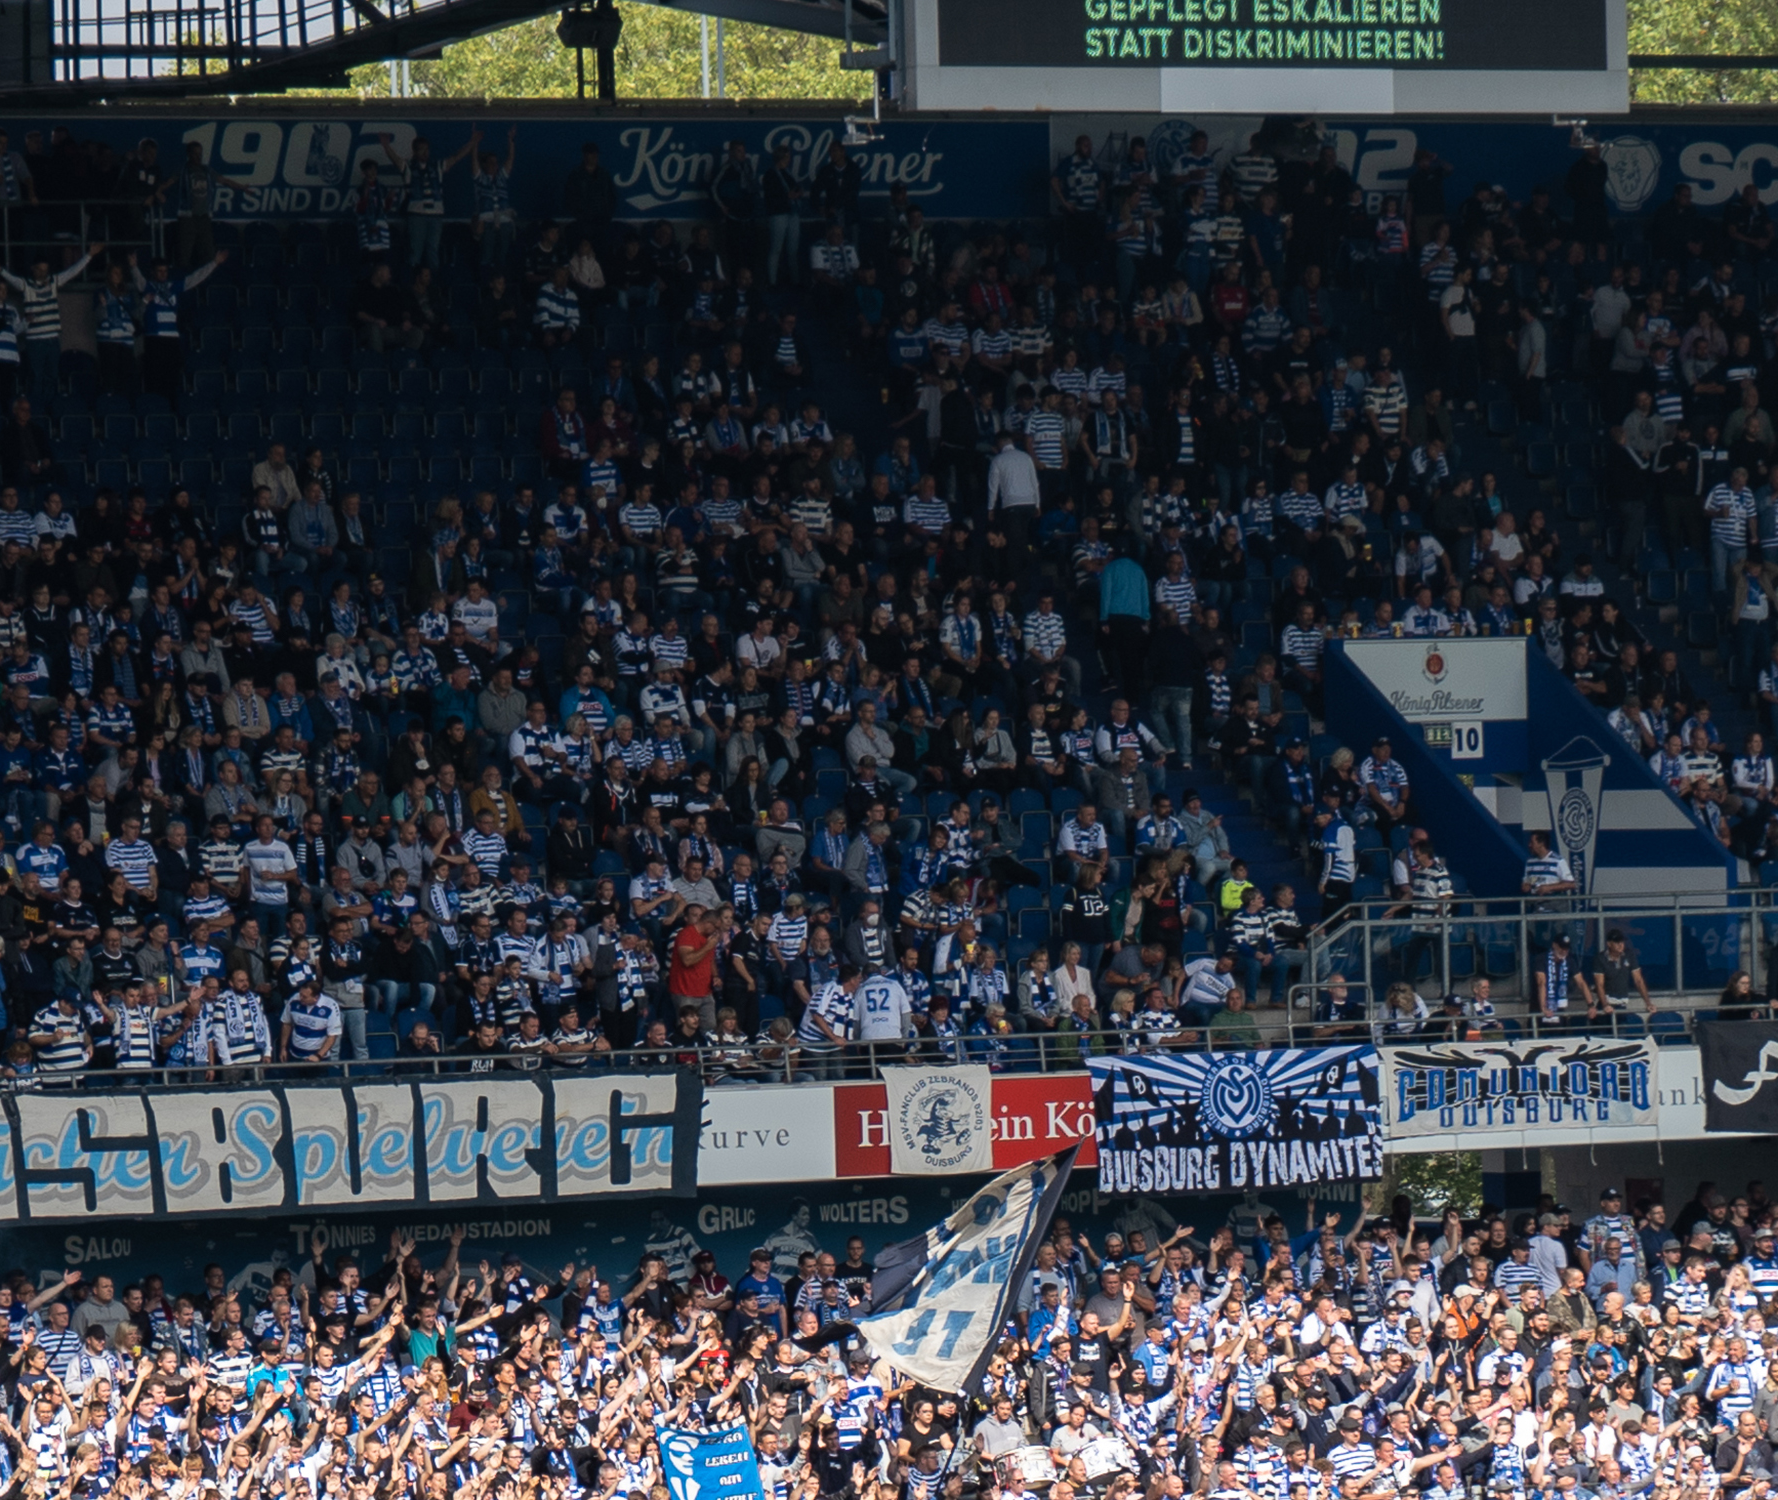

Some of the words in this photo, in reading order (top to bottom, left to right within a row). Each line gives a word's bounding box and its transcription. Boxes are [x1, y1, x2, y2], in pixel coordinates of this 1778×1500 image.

[1085, 28, 1173, 59] STATT
[1182, 27, 1445, 61] DISKRIMINIEREN!
[182, 122, 418, 187] 1902
[249, 188, 312, 212] SIND
[1390, 690, 1434, 715] König
[1430, 688, 1485, 712] Pilsener
[1453, 726, 1480, 753] 10
[1439, 1096, 1611, 1129] DUISBURG
[225, 1092, 676, 1206] Spielverein
[924, 1142, 974, 1169] DUISBURG
[1098, 1144, 1221, 1194] DUISBURG
[1229, 1134, 1384, 1188] DYNAMITES
[697, 1203, 756, 1236] GRLIC
[819, 1195, 909, 1226] WOLTERS
[288, 1217, 377, 1256] TÖNNIES
[396, 1218, 552, 1244] WEDAUSTADION
[64, 1234, 132, 1266] SALOU
